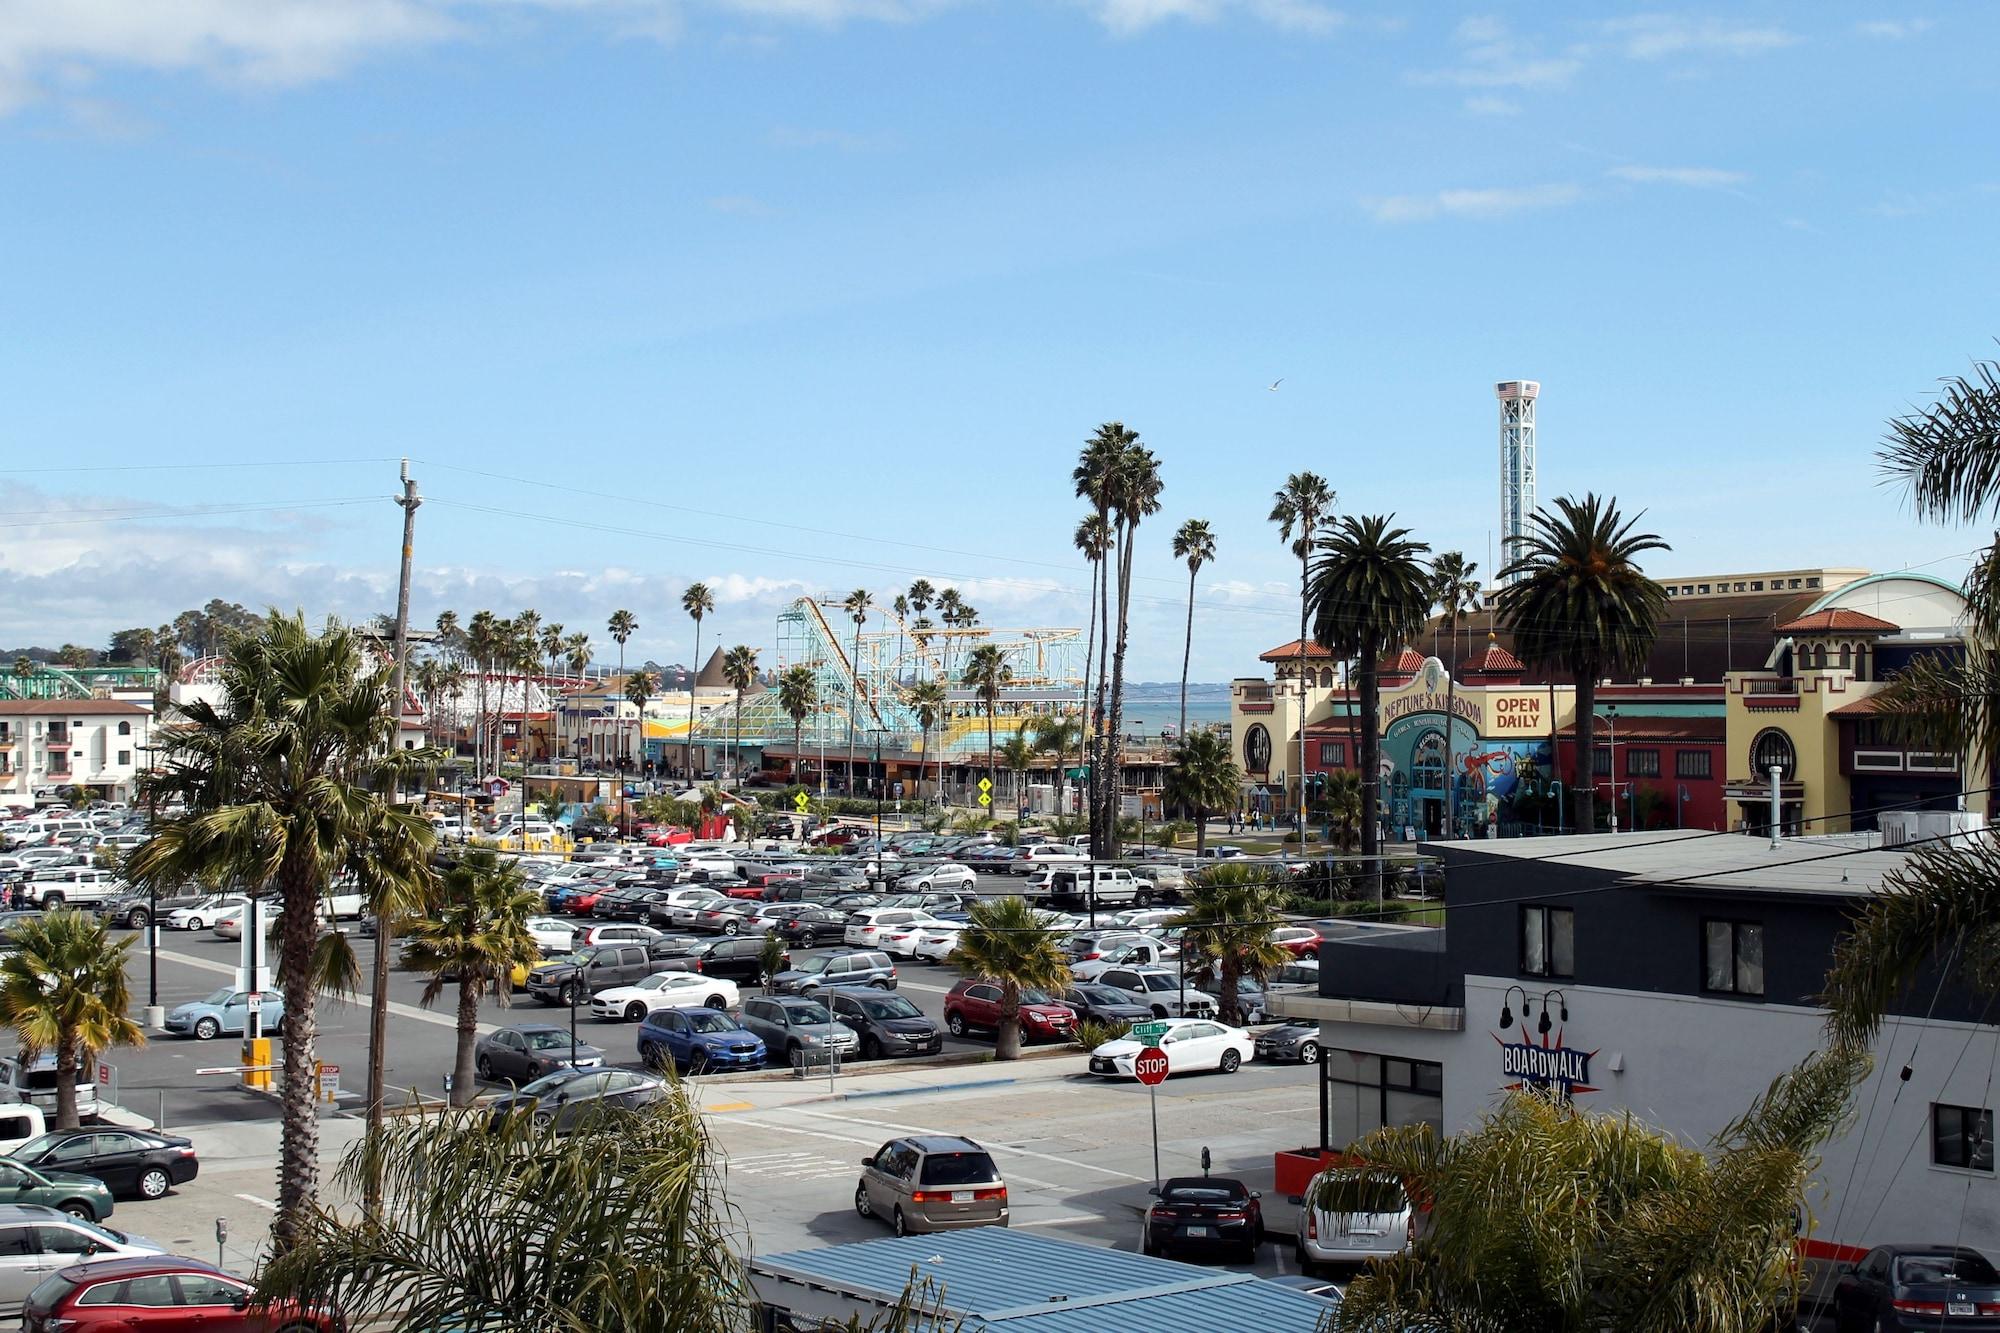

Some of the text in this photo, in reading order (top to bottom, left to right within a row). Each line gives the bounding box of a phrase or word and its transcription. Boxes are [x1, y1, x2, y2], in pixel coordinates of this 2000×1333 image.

[1384, 691, 1433, 723] NEPTUNE'S
[1496, 698, 1540, 713] OPEN
[1496, 715, 1540, 728] DAILY
[1078, 768, 1086, 778] A
[1137, 1058, 1167, 1075] STOP
[1504, 1047, 1584, 1082] BOARDWALK
[1522, 1078, 1567, 1103] BWL
